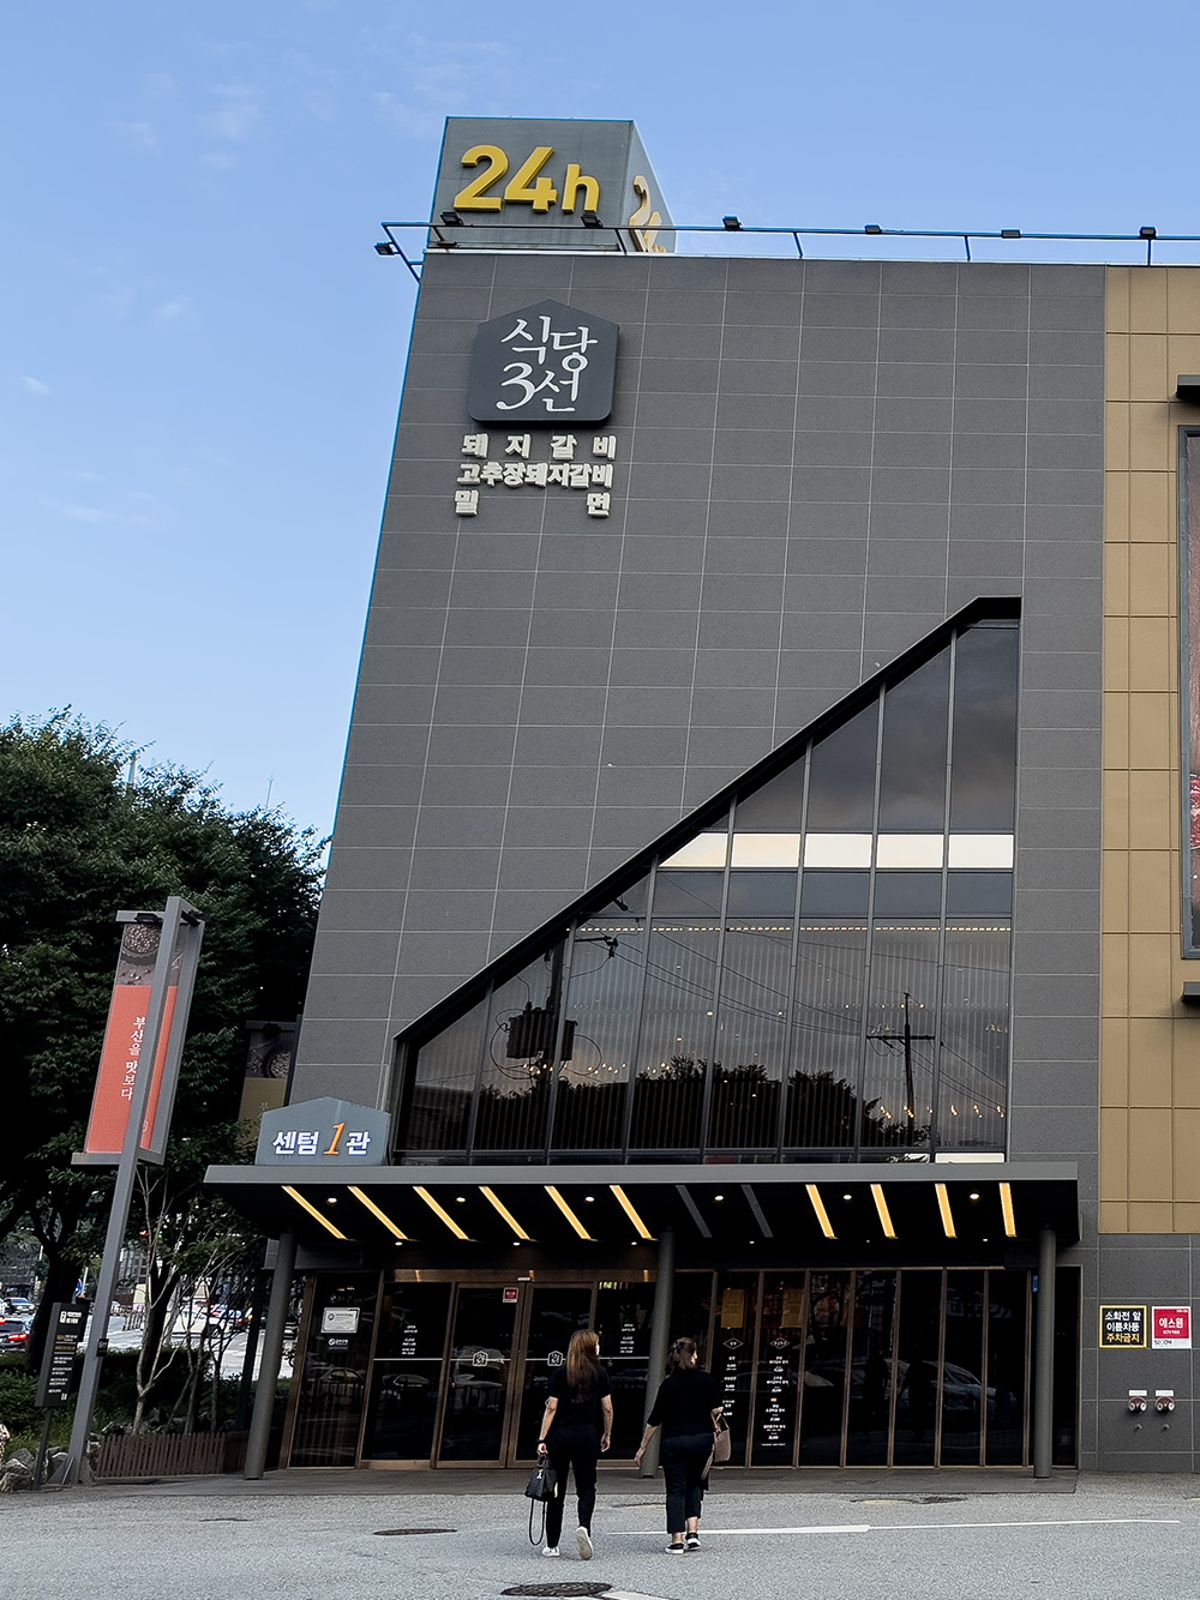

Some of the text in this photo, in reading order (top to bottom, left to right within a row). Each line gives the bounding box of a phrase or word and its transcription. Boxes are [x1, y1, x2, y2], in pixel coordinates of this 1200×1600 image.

[453, 144, 600, 213] 24h
[501, 316, 598, 372] 식당
[496, 362, 576, 412] 3선
[457, 461, 614, 489] 고추장돼지갈비
[121, 1016, 146, 1101] 부산을 맛보다
[1105, 1311, 1130, 1321] 소화전
[1158, 1317, 1184, 1329] 에스원
[1106, 1333, 1140, 1343] 주차금지
